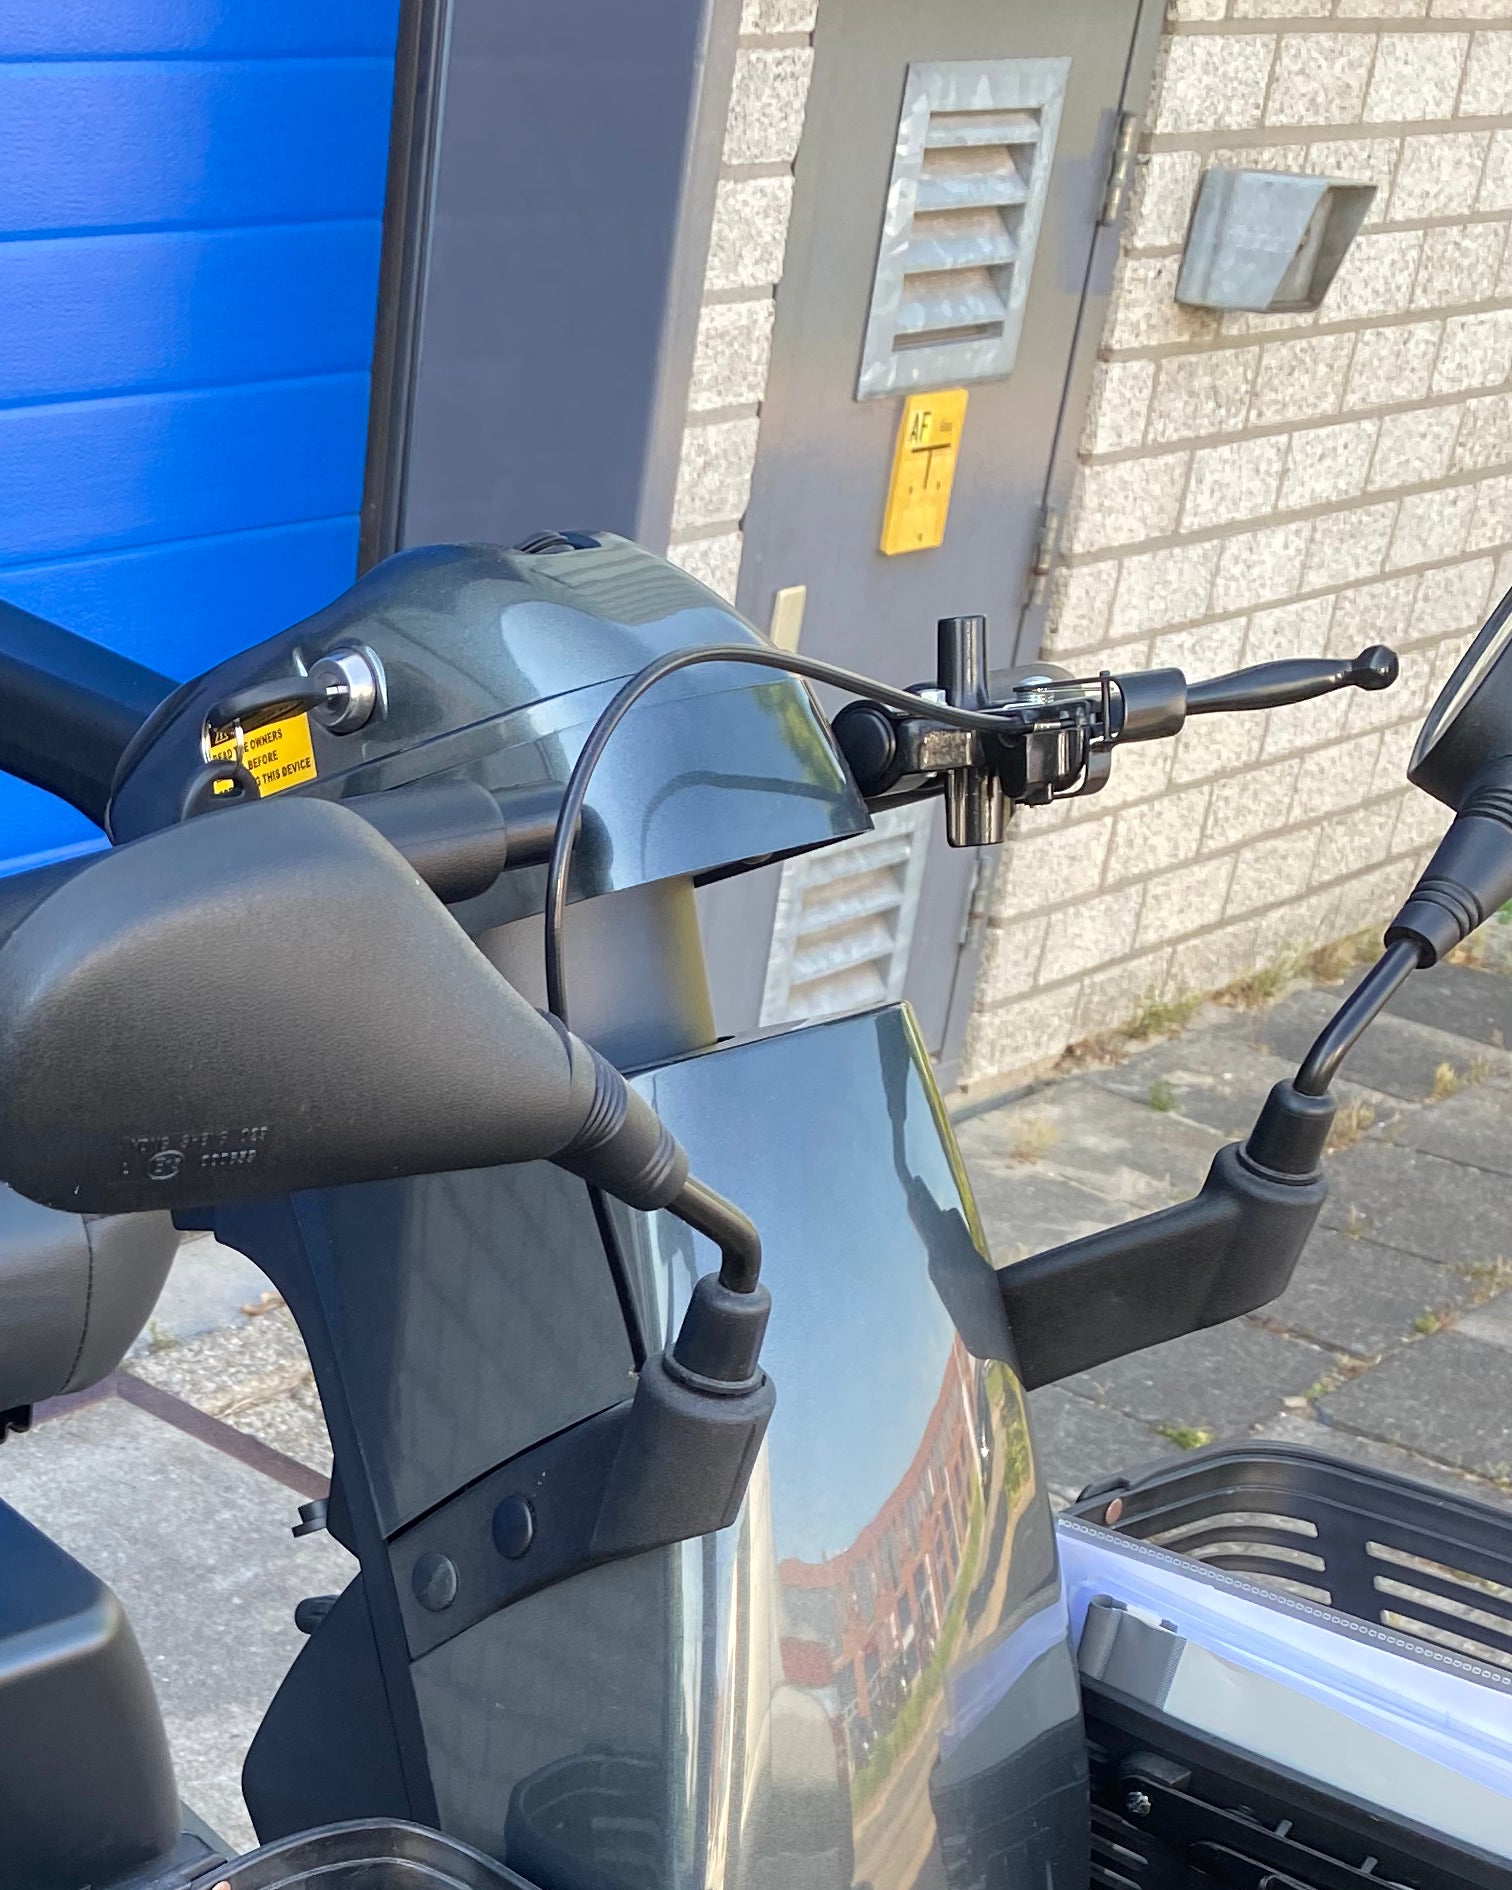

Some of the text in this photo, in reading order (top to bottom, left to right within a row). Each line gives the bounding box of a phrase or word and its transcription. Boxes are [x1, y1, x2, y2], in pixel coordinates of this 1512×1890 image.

[906, 411, 932, 442] AF
[250, 728, 283, 750] OWNERS
[248, 750, 279, 770] BEFORE
[263, 769, 281, 785] THIS
[282, 757, 311, 777] DEVICE
